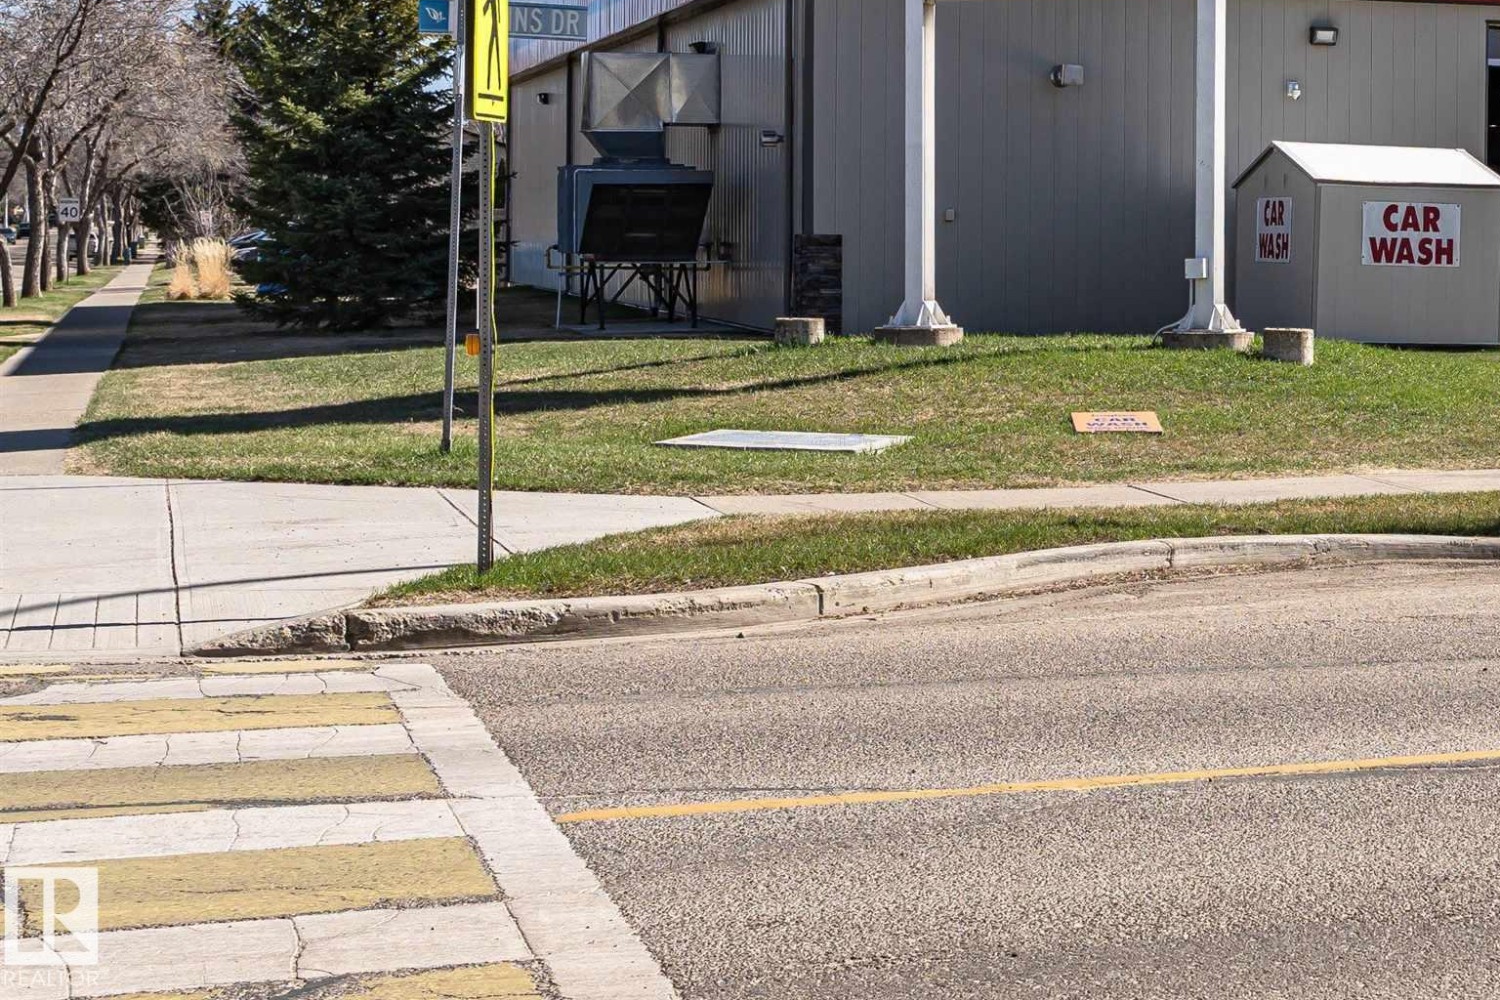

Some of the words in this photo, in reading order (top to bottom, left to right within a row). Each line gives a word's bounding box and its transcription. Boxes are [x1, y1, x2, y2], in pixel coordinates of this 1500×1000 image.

[509, 7, 543, 34] NS
[551, 9, 579, 35] DR
[60, 206, 78, 218] 40
[1264, 200, 1284, 227] CAR
[1383, 204, 1441, 233] CAR
[1259, 233, 1289, 260] WASH
[1369, 237, 1454, 266] WASH
